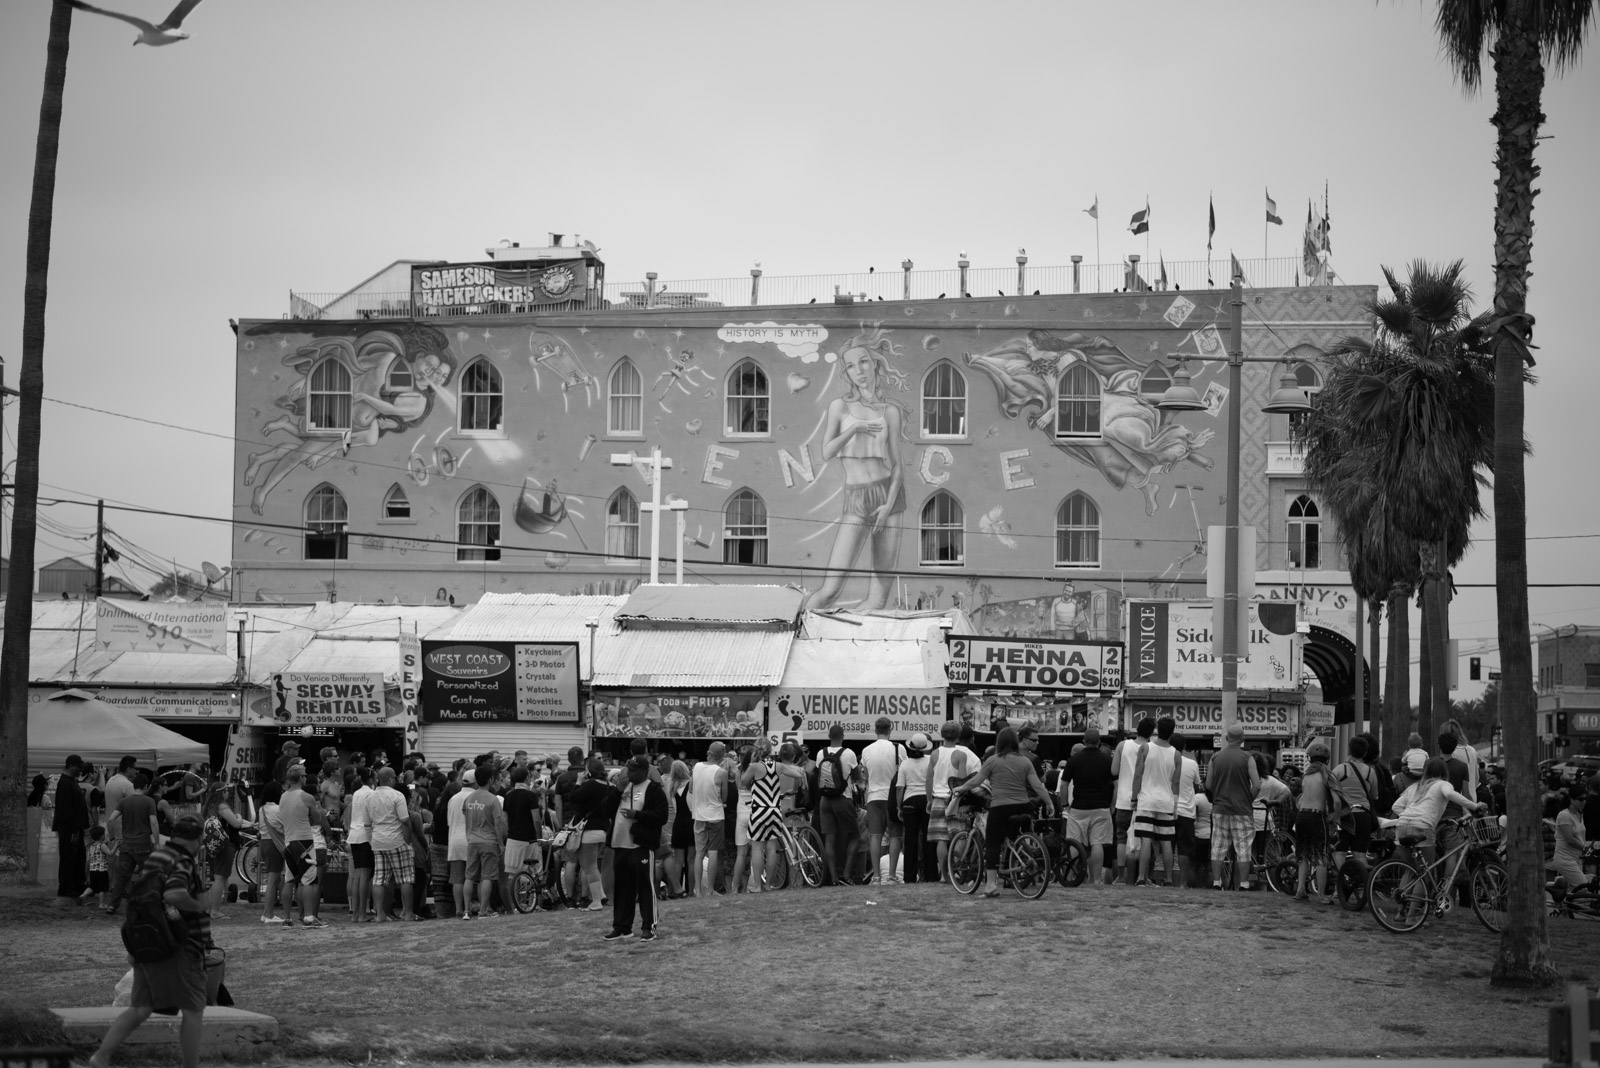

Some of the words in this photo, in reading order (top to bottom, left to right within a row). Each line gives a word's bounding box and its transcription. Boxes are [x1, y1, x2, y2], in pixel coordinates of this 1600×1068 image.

[421, 267, 495, 289] SAMESUN
[421, 286, 535, 306] BACKPACKERS
[726, 329, 768, 338] HISTORY
[775, 329, 784, 338] IS
[790, 329, 819, 338] MYTH
[98, 607, 152, 621] Unlimited
[153, 611, 226, 623] International
[146, 623, 183, 641] $10
[1176, 628, 1271, 645] Sidelk
[1140, 607, 1156, 678] VENICE
[525, 647, 562, 658] Keychains
[953, 641, 966, 659] 2
[1176, 648, 1252, 664] Mart
[430, 653, 462, 666] WEST
[466, 653, 504, 666] COAST
[986, 647, 1087, 667] HENNA
[1105, 648, 1118, 666] 2
[446, 664, 489, 676] Souvenirs
[525, 660, 538, 669] 3-D
[539, 660, 566, 669] Photos
[949, 661, 968, 669] FOR
[525, 672, 557, 683] Crystals
[949, 670, 968, 682] $10
[970, 663, 1101, 687] TATTOOS
[1102, 667, 1120, 676] FOR
[290, 674, 303, 683] Do
[303, 674, 330, 683] Venice
[1101, 677, 1120, 688] $10
[436, 679, 499, 691] Personalized
[526, 685, 558, 694] Watches
[296, 684, 377, 699] SEGWAY
[99, 696, 149, 706] Boardwalk
[149, 696, 230, 706] Communications
[403, 654, 418, 751] SEGWAY
[450, 694, 487, 705] Custom
[526, 697, 563, 706] Novelties
[801, 694, 860, 716] VENICE
[864, 694, 942, 717] MASSAGE
[295, 700, 382, 715] RENTALS
[526, 709, 549, 718] Photo
[550, 709, 577, 718] Frames
[440, 709, 467, 720] Made
[472, 709, 499, 720] Gifts
[1175, 705, 1288, 723] SUNGASSES
[1305, 709, 1333, 719] Kodak
[807, 720, 832, 732] BODY
[902, 720, 939, 735] Massage
